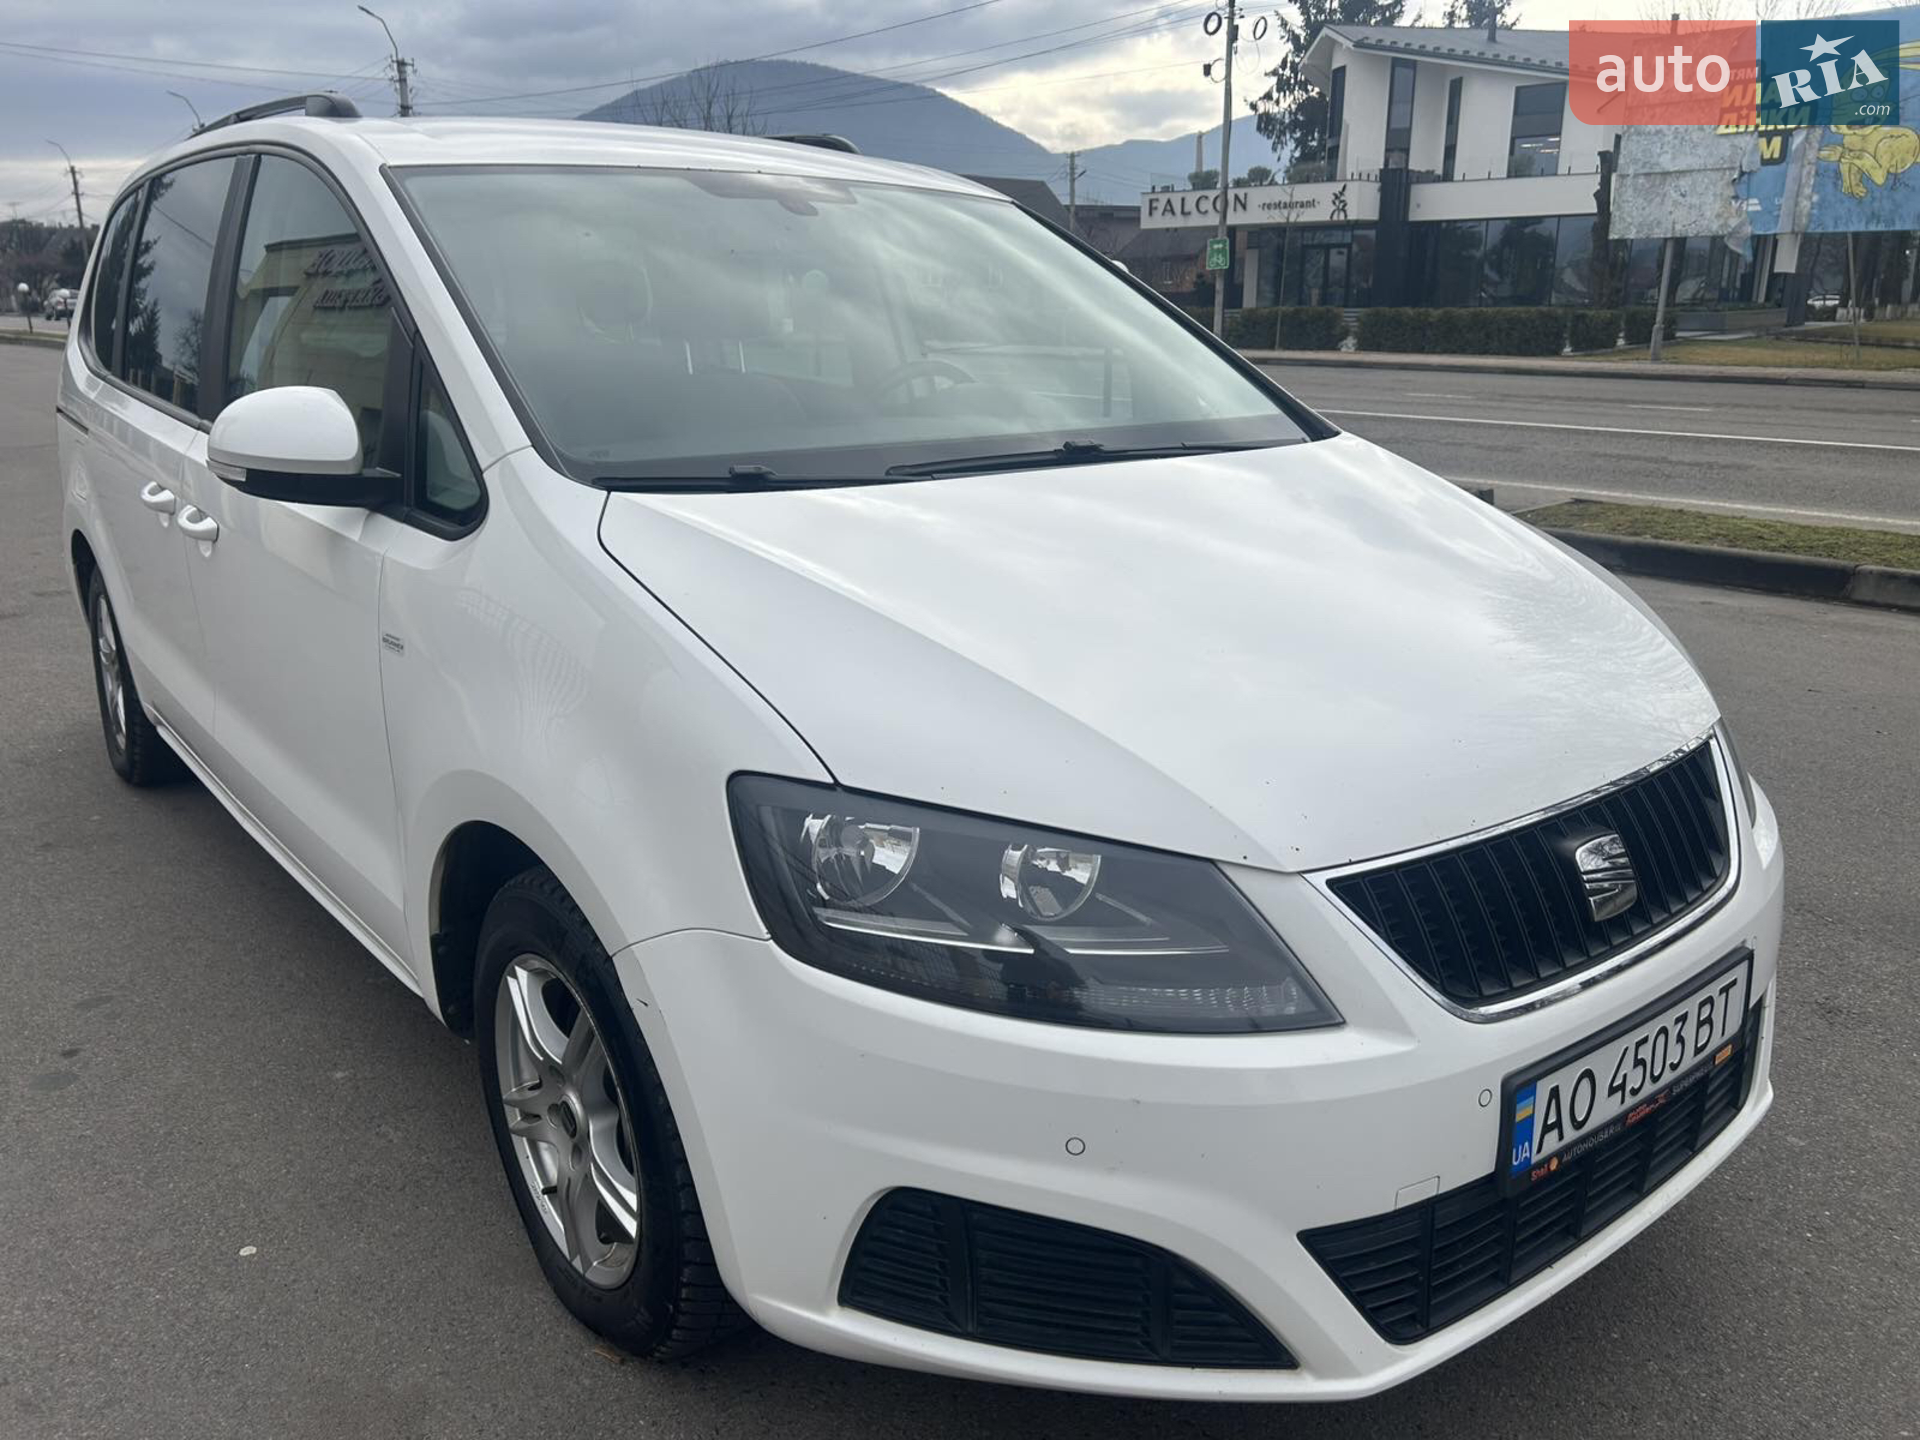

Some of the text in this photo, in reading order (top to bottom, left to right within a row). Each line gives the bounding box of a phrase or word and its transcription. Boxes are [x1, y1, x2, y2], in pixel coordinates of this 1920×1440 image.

[1148, 192, 1248, 217] FALCON
[1536, 1067, 1597, 1155] AO
[1607, 1010, 1689, 1106] 4503
[1693, 977, 1738, 1057] BT
[1512, 1141, 1531, 1166] UA
